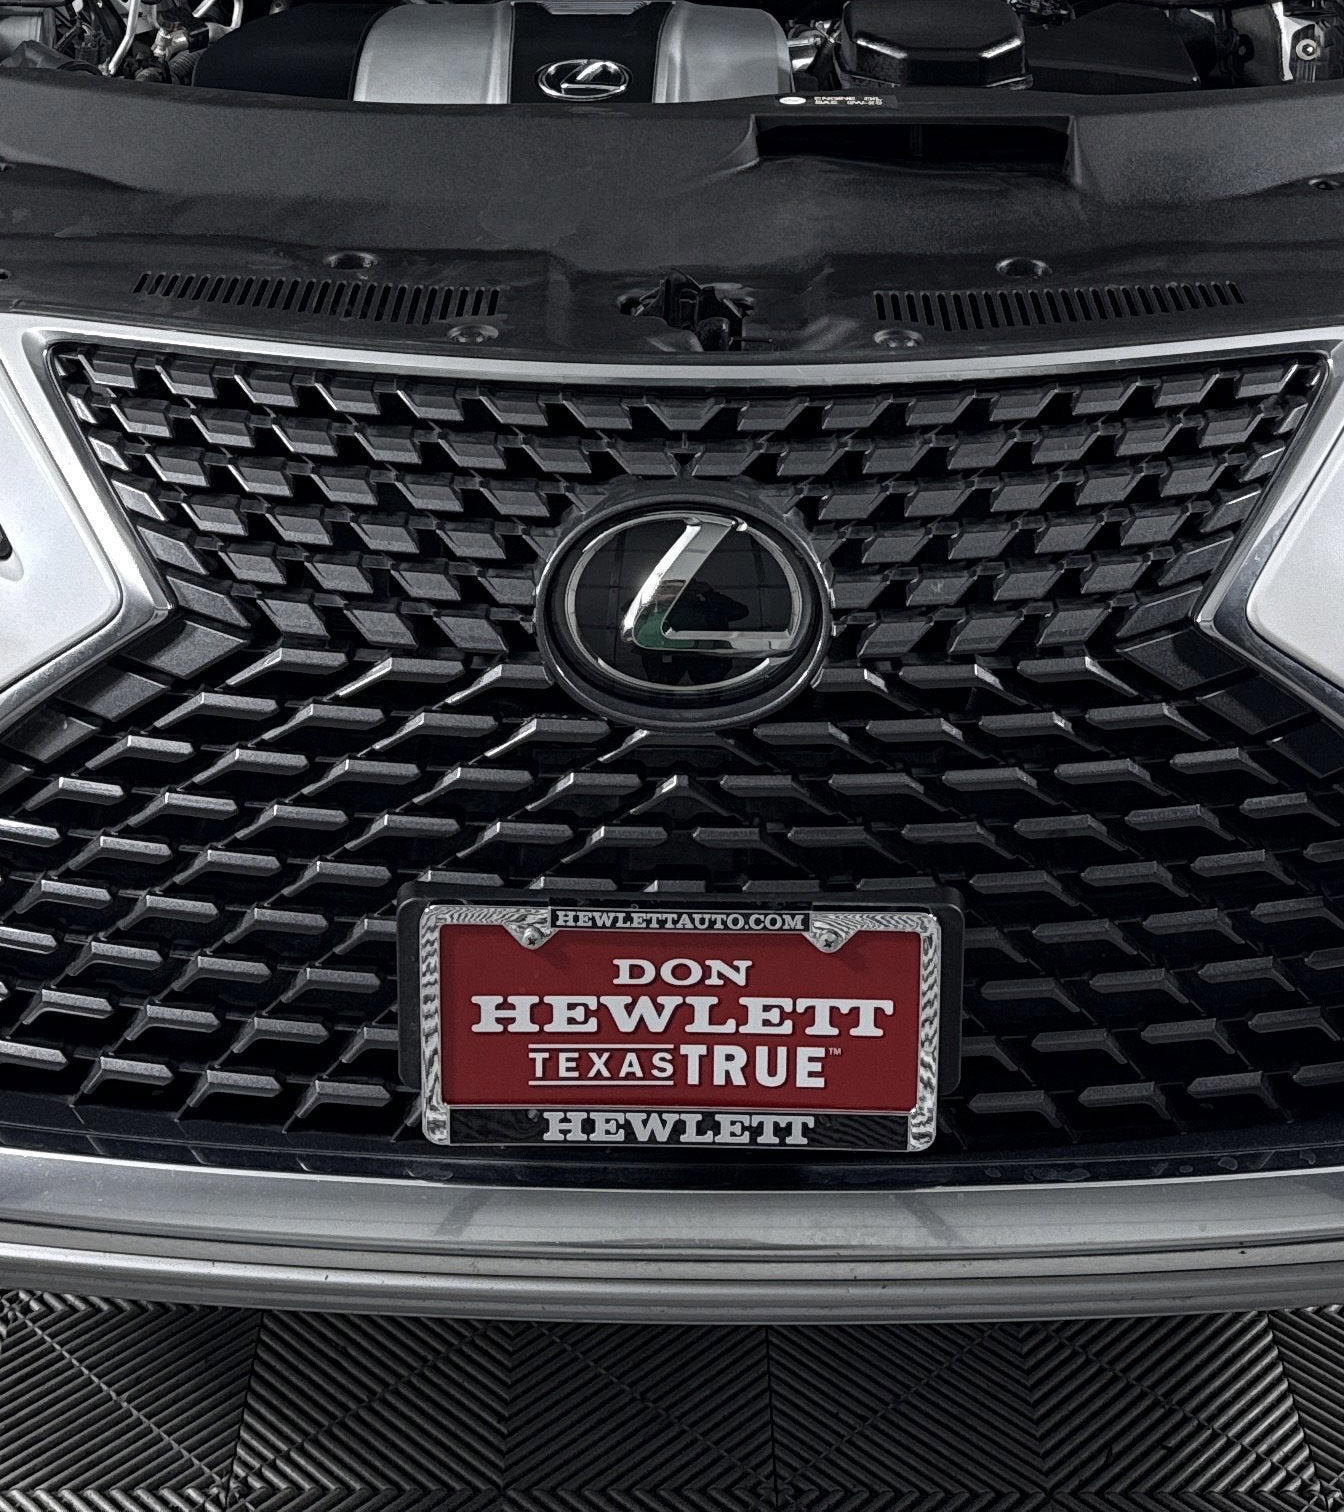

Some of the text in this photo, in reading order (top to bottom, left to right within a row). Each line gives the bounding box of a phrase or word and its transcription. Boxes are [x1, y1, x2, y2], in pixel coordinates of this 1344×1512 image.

[556, 910, 805, 931] HEWLETTAUTO.COM
[613, 959, 753, 987] DON
[471, 995, 894, 1037] HEWLETT
[543, 1111, 815, 1145] HEWLETT
